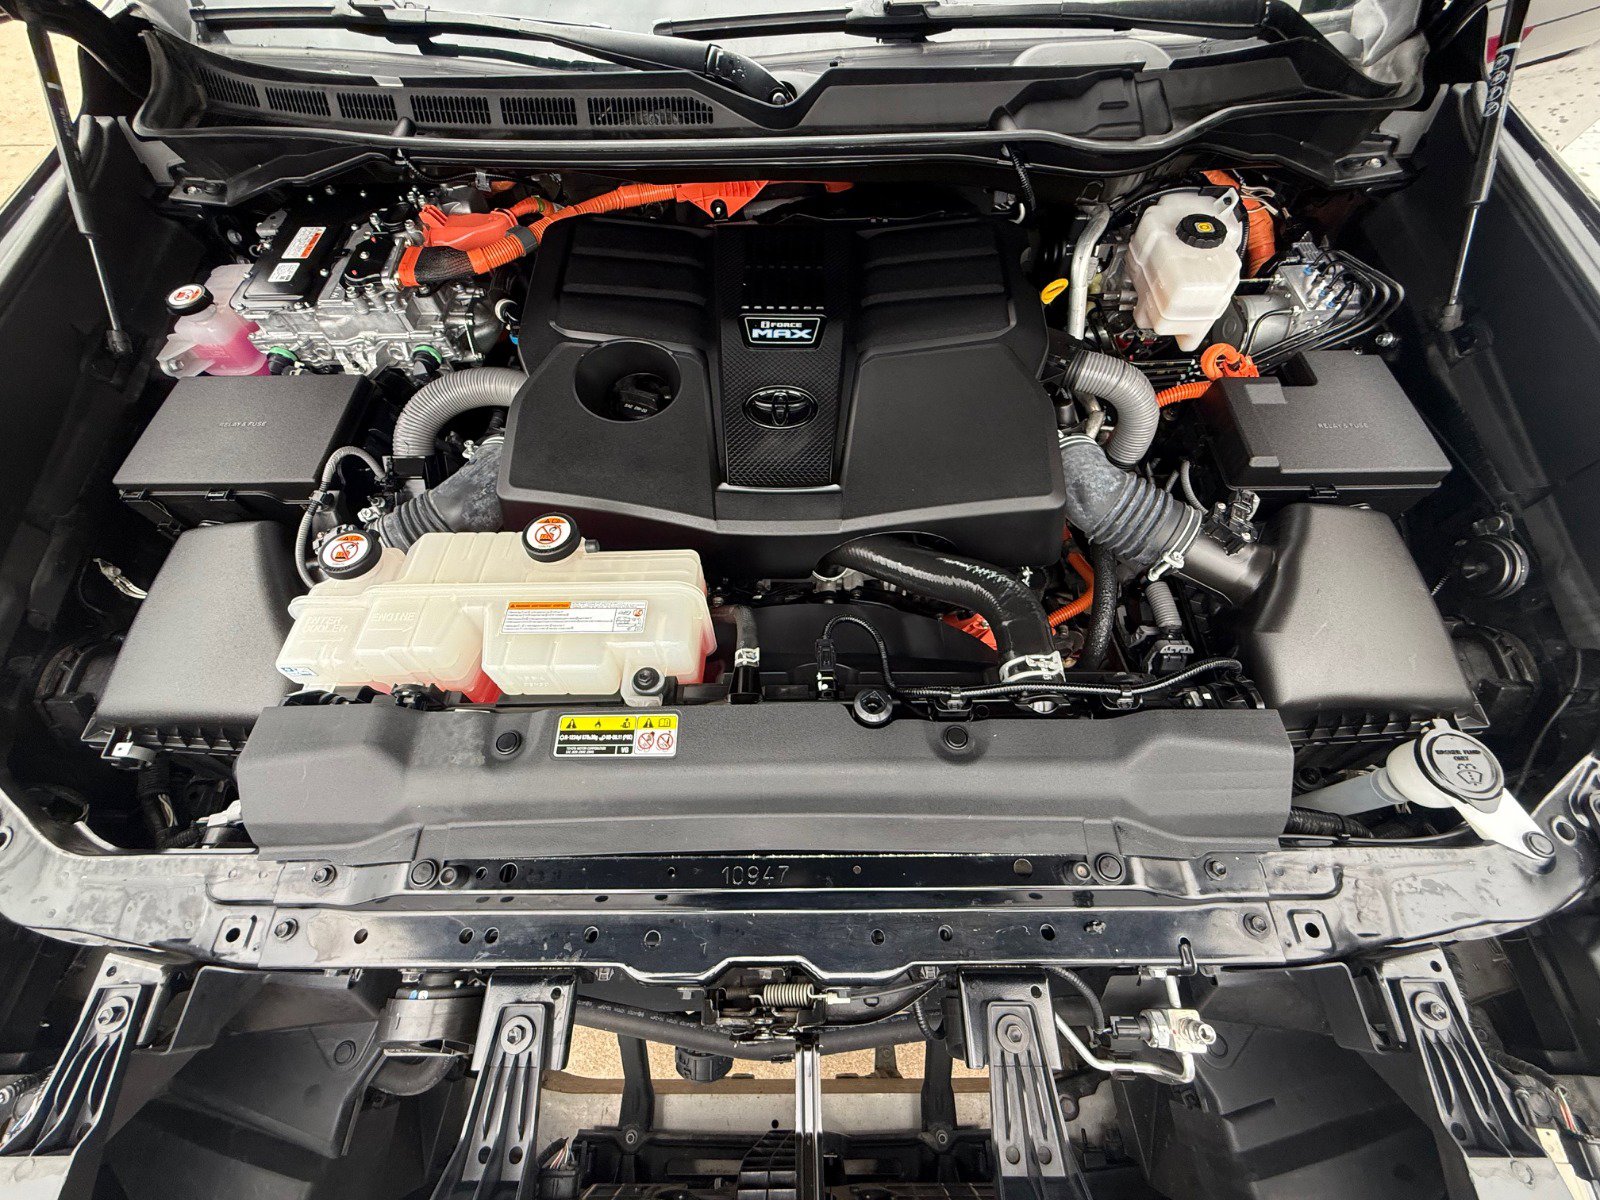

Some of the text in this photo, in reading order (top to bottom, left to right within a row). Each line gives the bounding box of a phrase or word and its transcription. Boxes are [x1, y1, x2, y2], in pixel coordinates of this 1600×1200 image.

[752, 328, 812, 339] MAX
[372, 611, 416, 621] ENGINE
[721, 865, 789, 885] 10947
